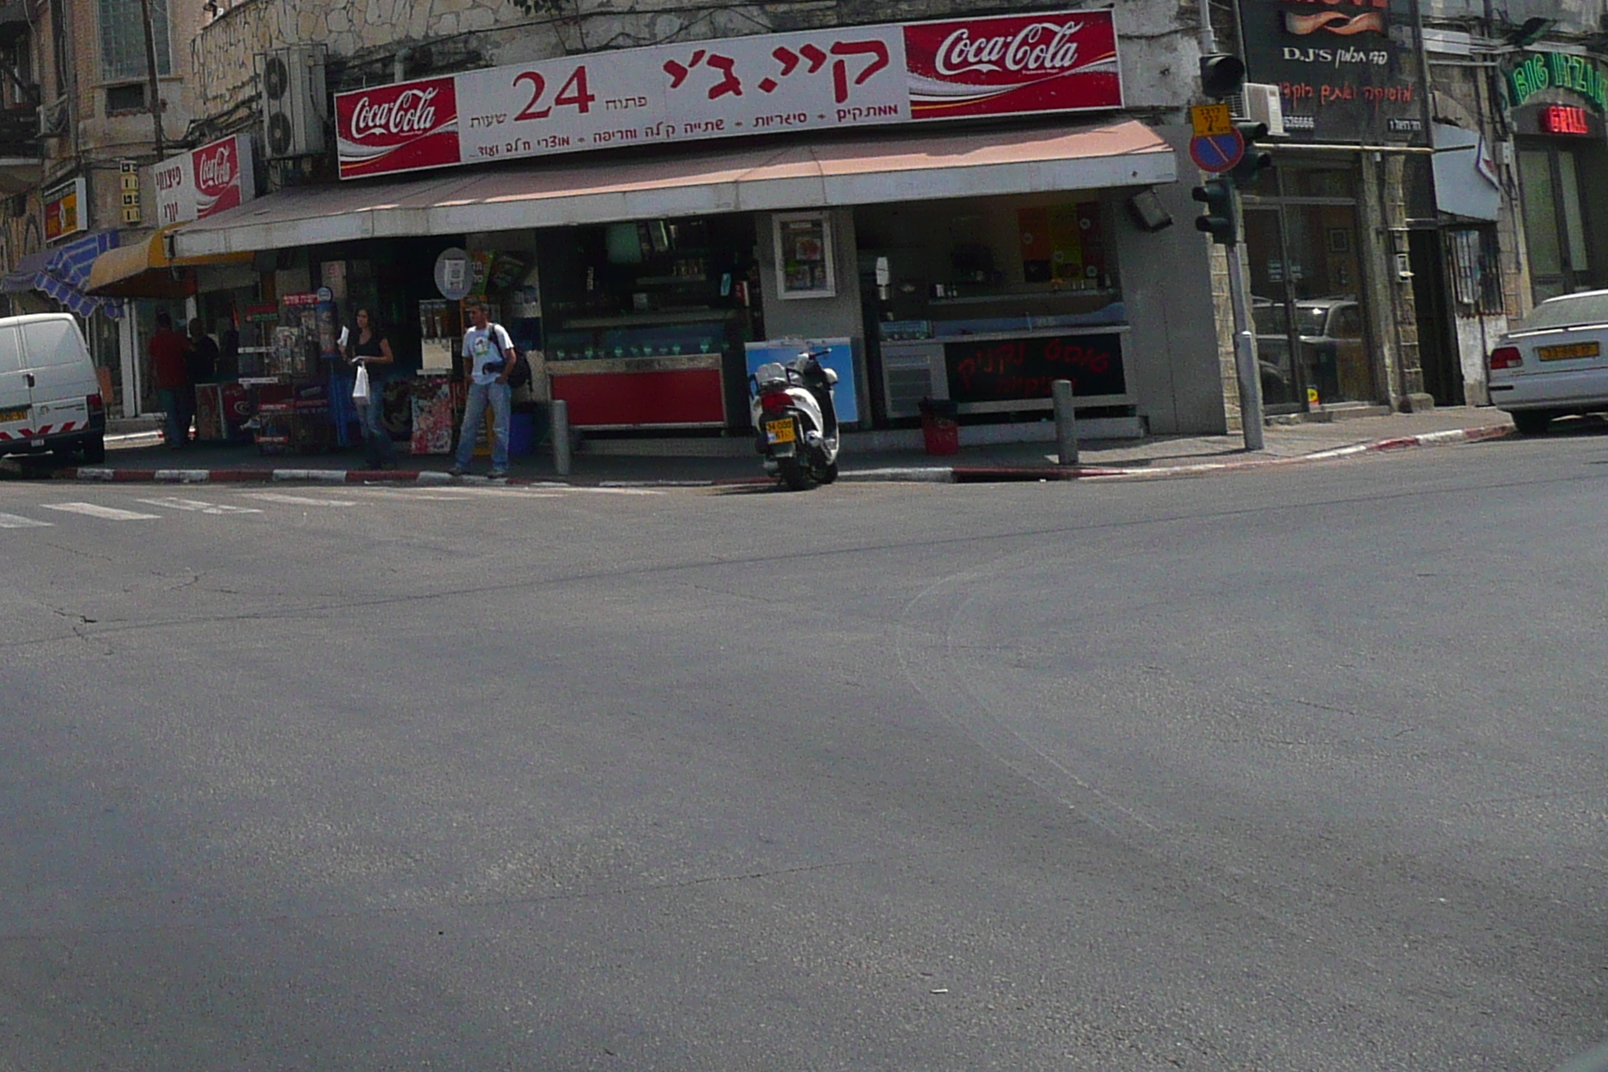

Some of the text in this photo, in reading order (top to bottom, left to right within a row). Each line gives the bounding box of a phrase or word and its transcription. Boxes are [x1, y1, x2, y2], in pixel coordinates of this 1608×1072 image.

[935, 20, 1085, 76] Coca-Cola
[1513, 53, 1549, 105] BIG
[469, 65, 648, 130] פתוח 24 שעות
[351, 87, 440, 140] Coca-Cola
[752, 112, 808, 128] סיגריות
[836, 104, 899, 123] ממתקים
[1548, 105, 1589, 135] GRILL
[645, 121, 676, 139] קלה
[684, 118, 726, 134] שתייה
[505, 137, 531, 153] חלב
[537, 135, 571, 149] מוצרי
[593, 128, 638, 144] וחריפה
[199, 143, 231, 189] Coca-Cola
